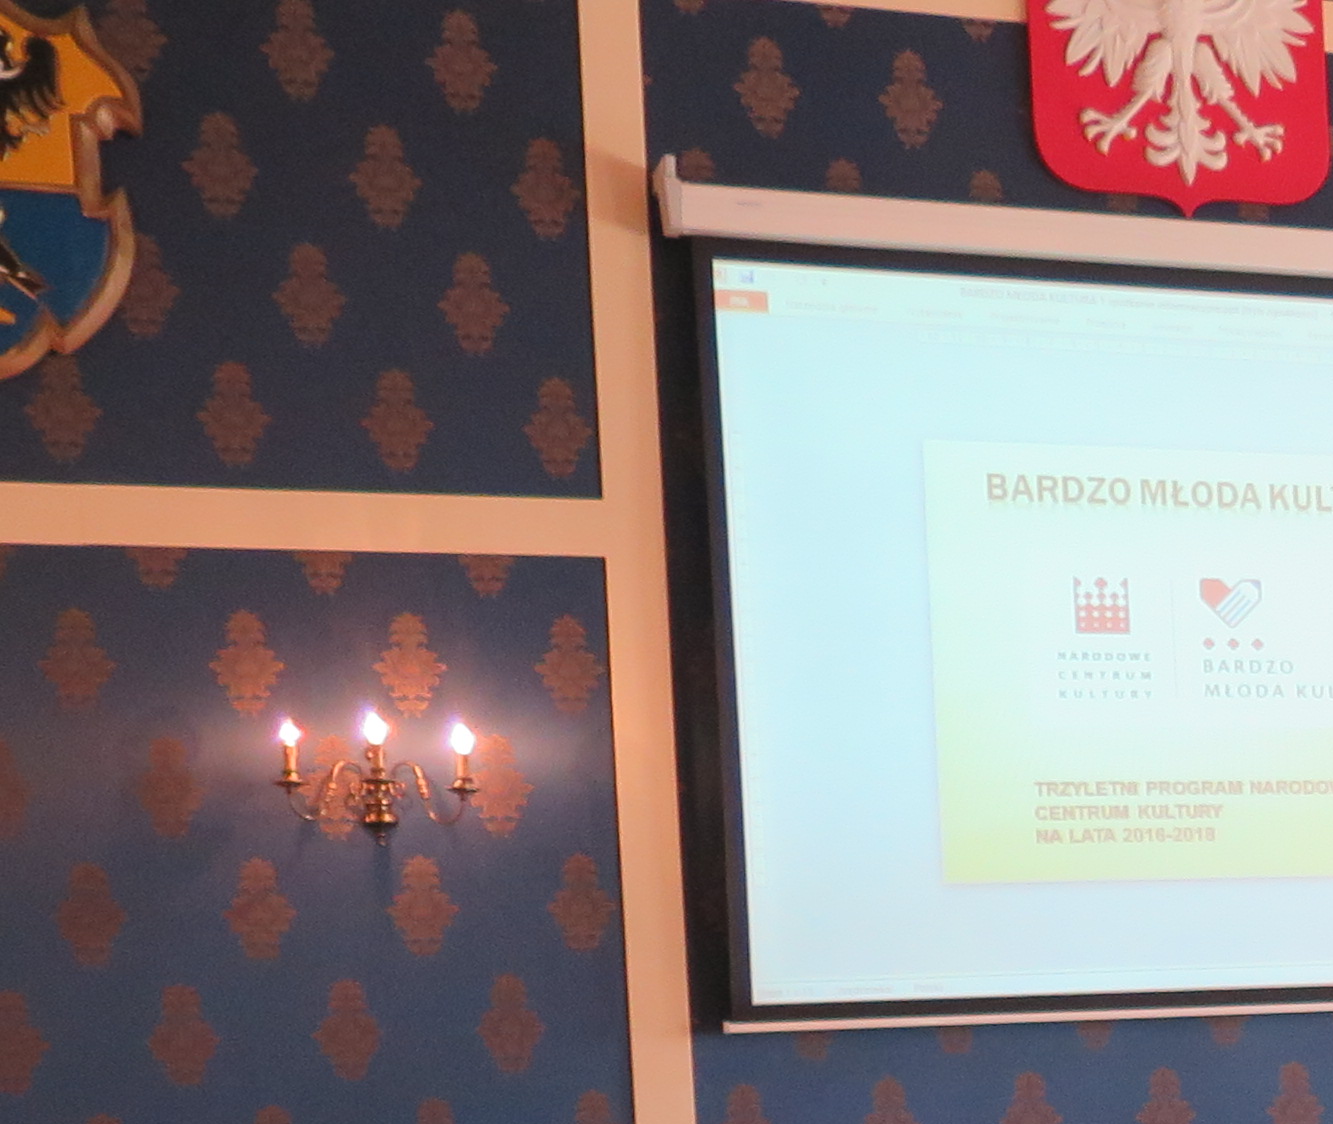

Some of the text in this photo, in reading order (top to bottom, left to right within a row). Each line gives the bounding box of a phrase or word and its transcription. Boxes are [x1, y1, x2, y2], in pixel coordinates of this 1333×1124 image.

[986, 472, 1132, 506] BARDZO
[1139, 478, 1262, 511] MŁODA
[1057, 651, 1151, 662] NARODOWE
[1203, 658, 1295, 675] BARDZO
[1058, 670, 1152, 681] CENTRUM
[1058, 689, 1152, 700] KULTURY
[1204, 683, 1285, 699] MŁODA
[1034, 780, 1140, 797] TRZYLETNI
[1146, 780, 1244, 796] PROGRAM
[1034, 803, 1224, 822] CENTRUM KULTURY
[1035, 826, 1217, 845] NA LATA 2016-2018
